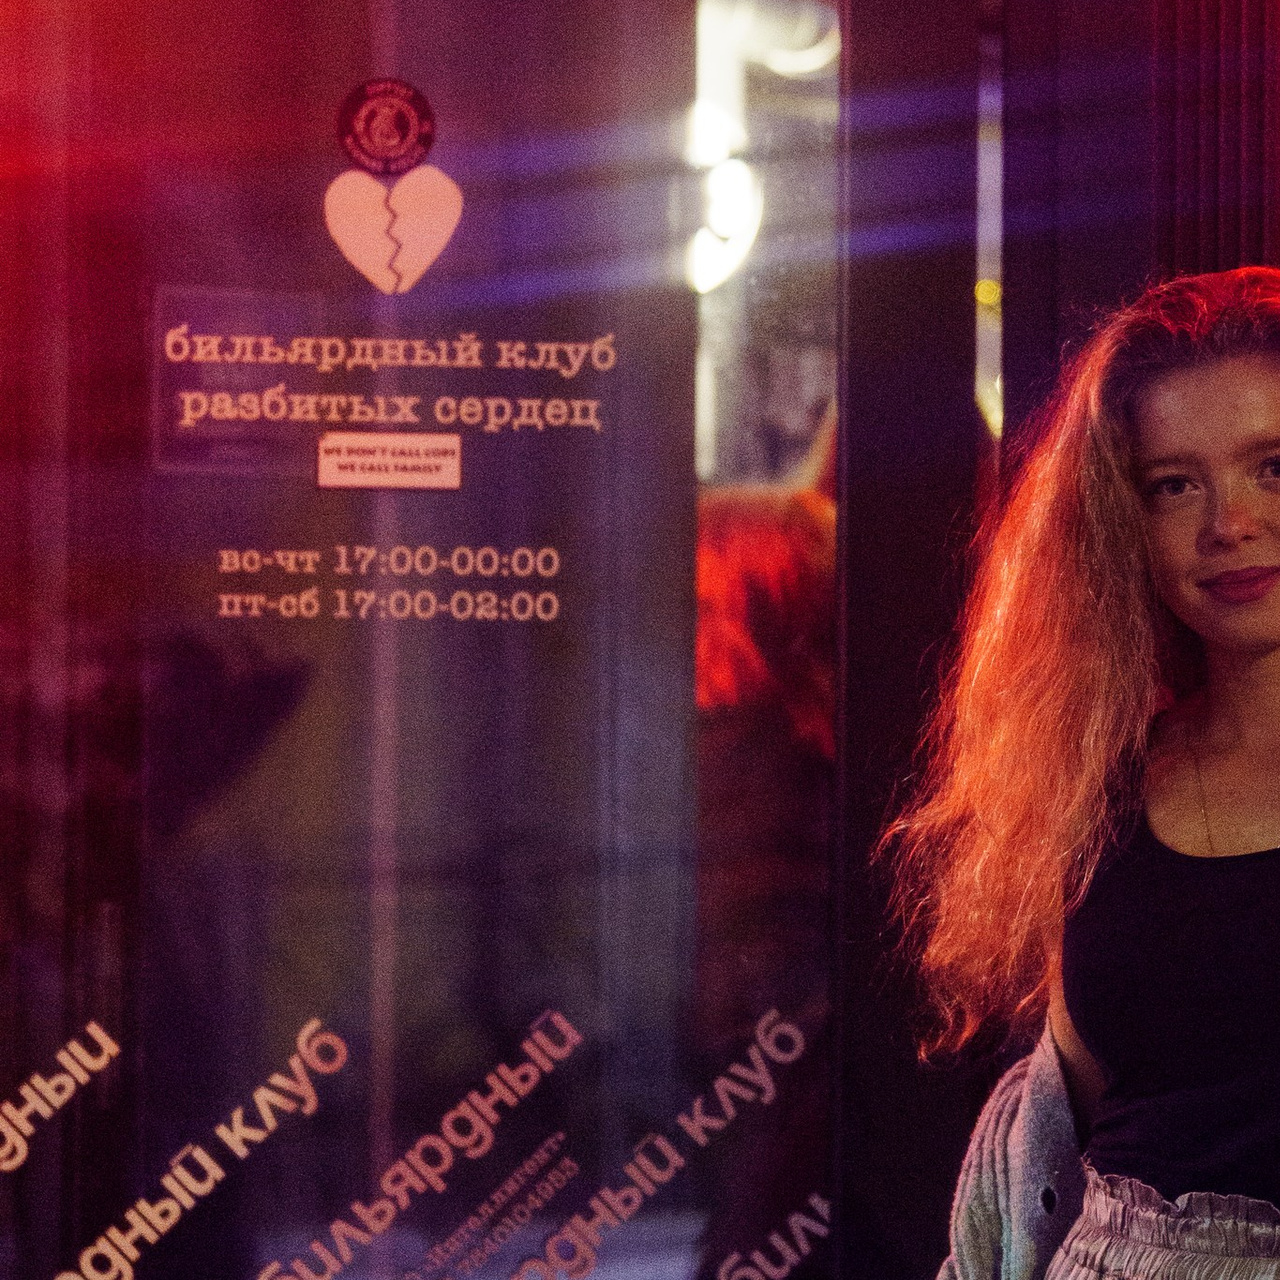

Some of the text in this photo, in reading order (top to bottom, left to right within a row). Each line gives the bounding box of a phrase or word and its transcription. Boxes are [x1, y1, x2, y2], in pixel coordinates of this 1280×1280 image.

[164, 323, 618, 379] бильярдный клуб
[178, 382, 602, 432] разбитых сердец
[333, 544, 562, 579] 17:00-00:00
[218, 586, 562, 622] пт-сб 17:00-02:00
[214, 1017, 348, 1160] клуб
[678, 1008, 806, 1147] клуб
